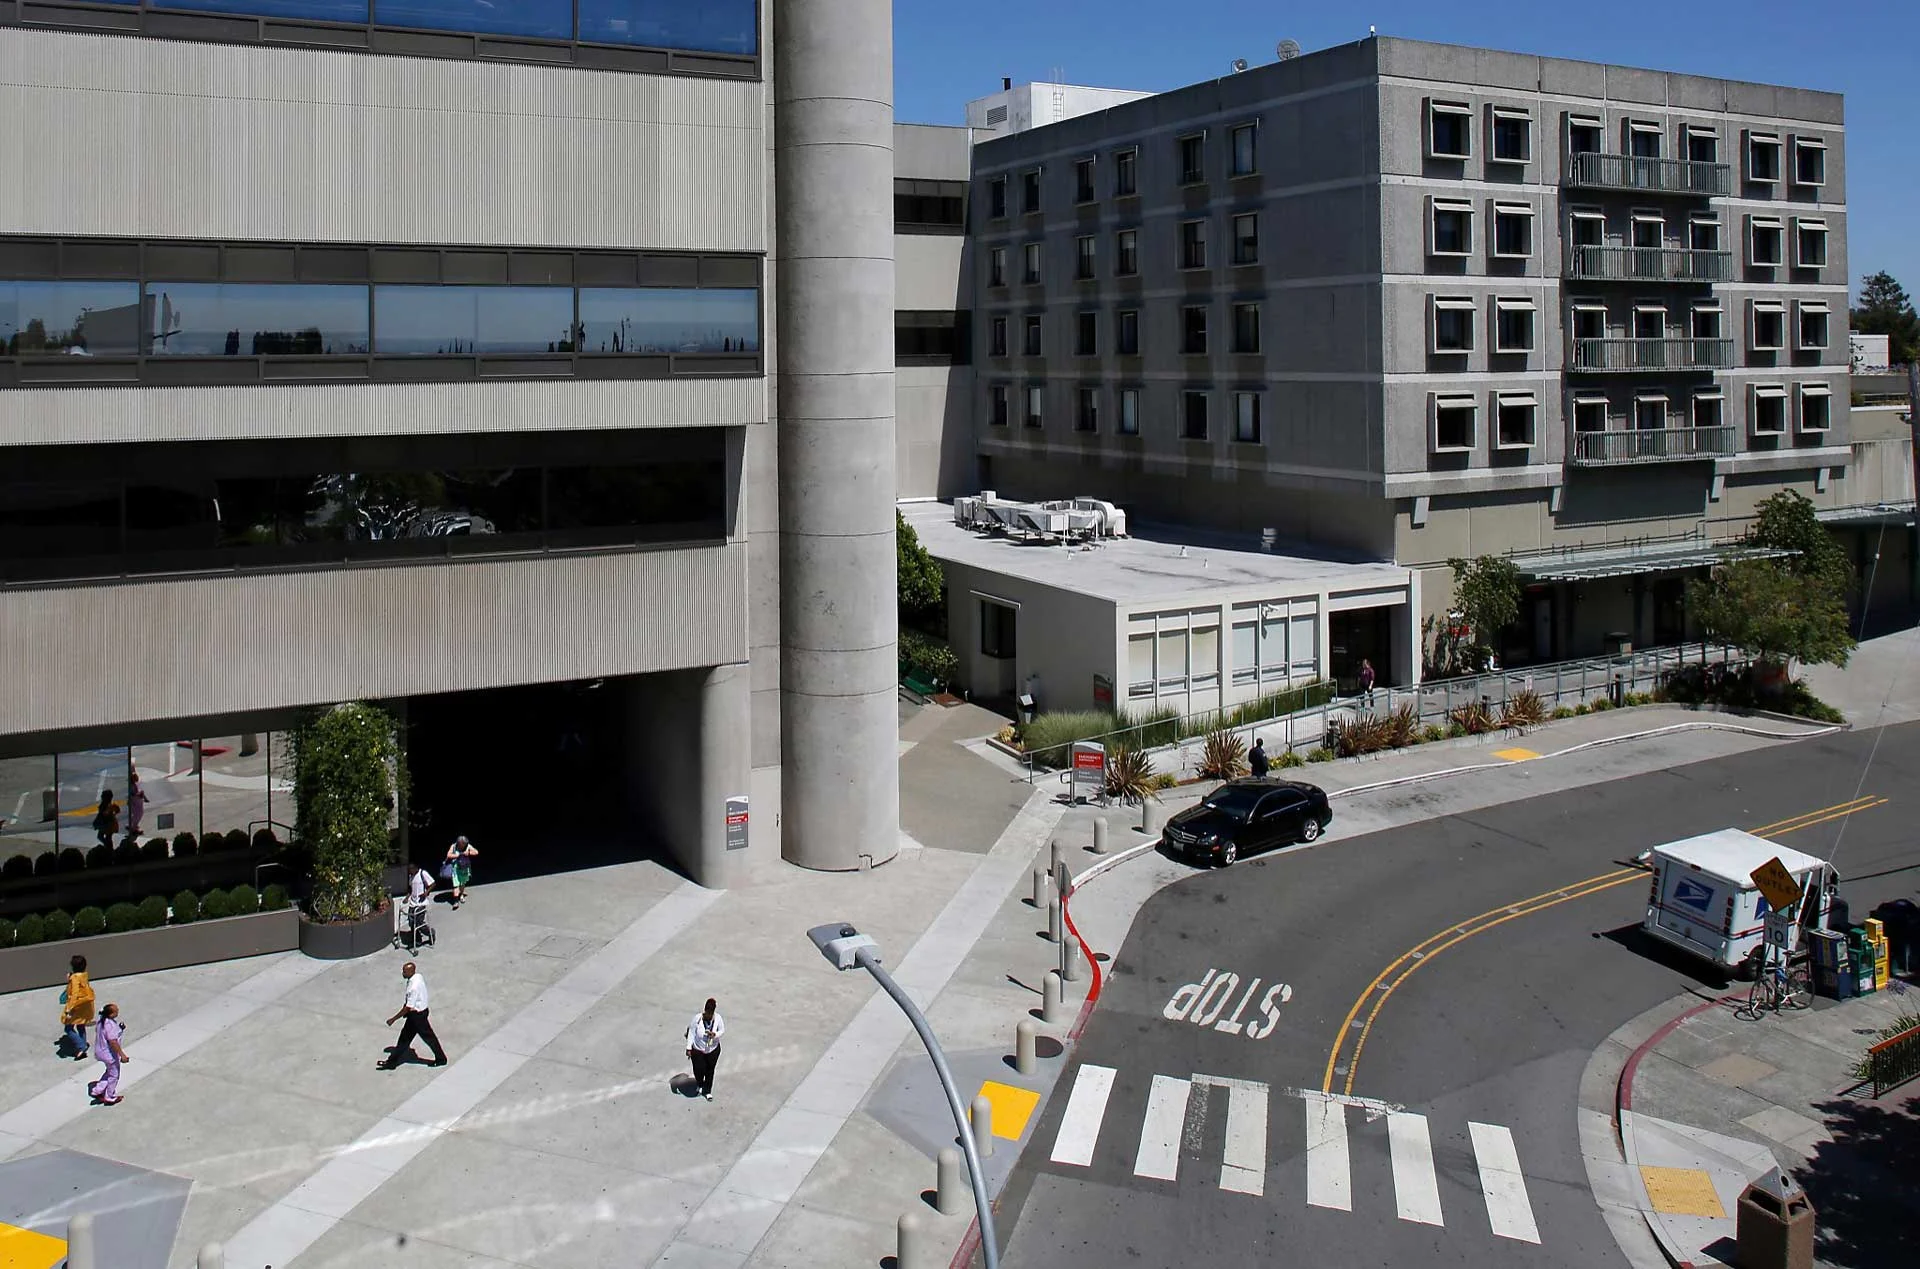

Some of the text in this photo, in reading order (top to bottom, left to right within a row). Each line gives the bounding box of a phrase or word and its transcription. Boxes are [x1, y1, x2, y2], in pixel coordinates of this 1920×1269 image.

[1770, 867, 1785, 879] NO
[1756, 875, 1802, 897] OUTLET
[1767, 927, 1784, 944] 10
[1162, 968, 1293, 1040] STOP
